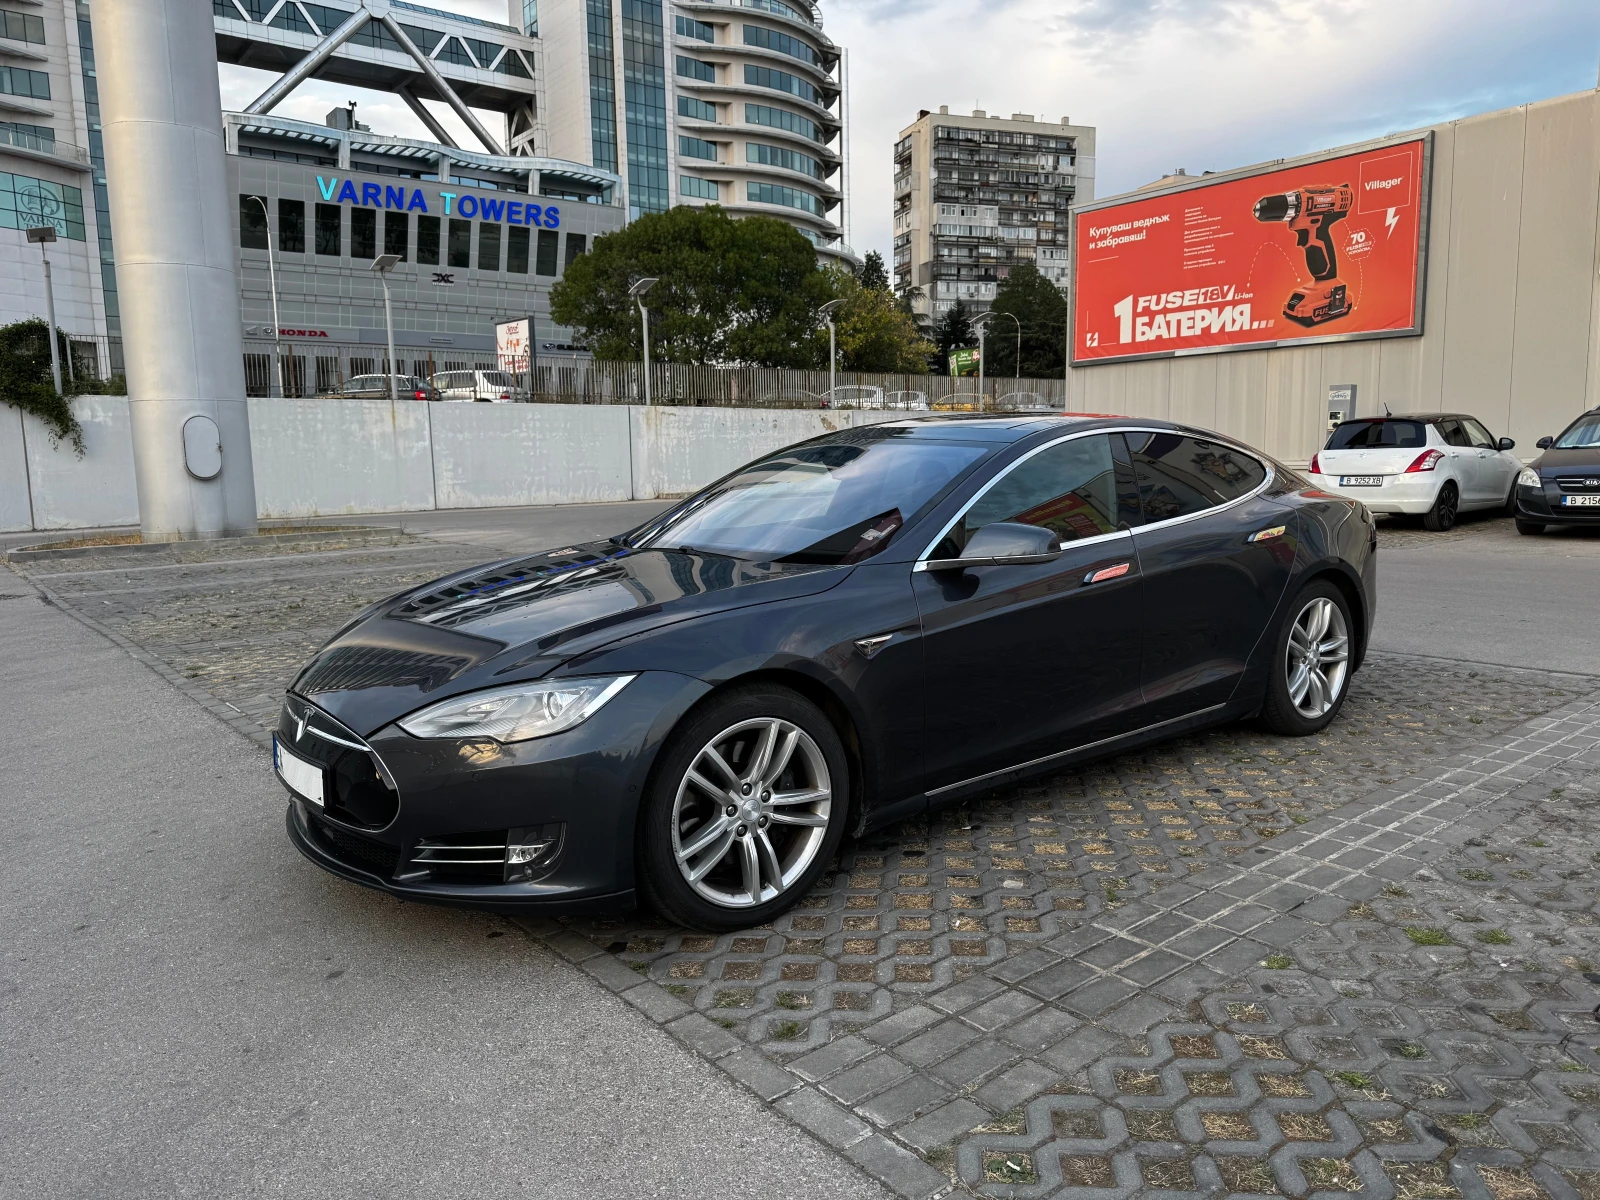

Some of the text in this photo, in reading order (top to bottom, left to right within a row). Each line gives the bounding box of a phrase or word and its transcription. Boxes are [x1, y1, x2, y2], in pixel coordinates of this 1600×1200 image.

[1364, 176, 1403, 191] Villager
[316, 175, 561, 229] VARNA TOWERS
[18, 212, 64, 229] VARNA
[1089, 221, 1132, 239] Купуваш
[1133, 214, 1170, 228] веднъж
[1089, 229, 1147, 250] и забравяш!
[1350, 231, 1366, 245] 70
[1113, 294, 1134, 344] 1
[278, 328, 329, 337] HONDA
[1354, 476, 1370, 485] 9252
[1570, 496, 1577, 505] B
